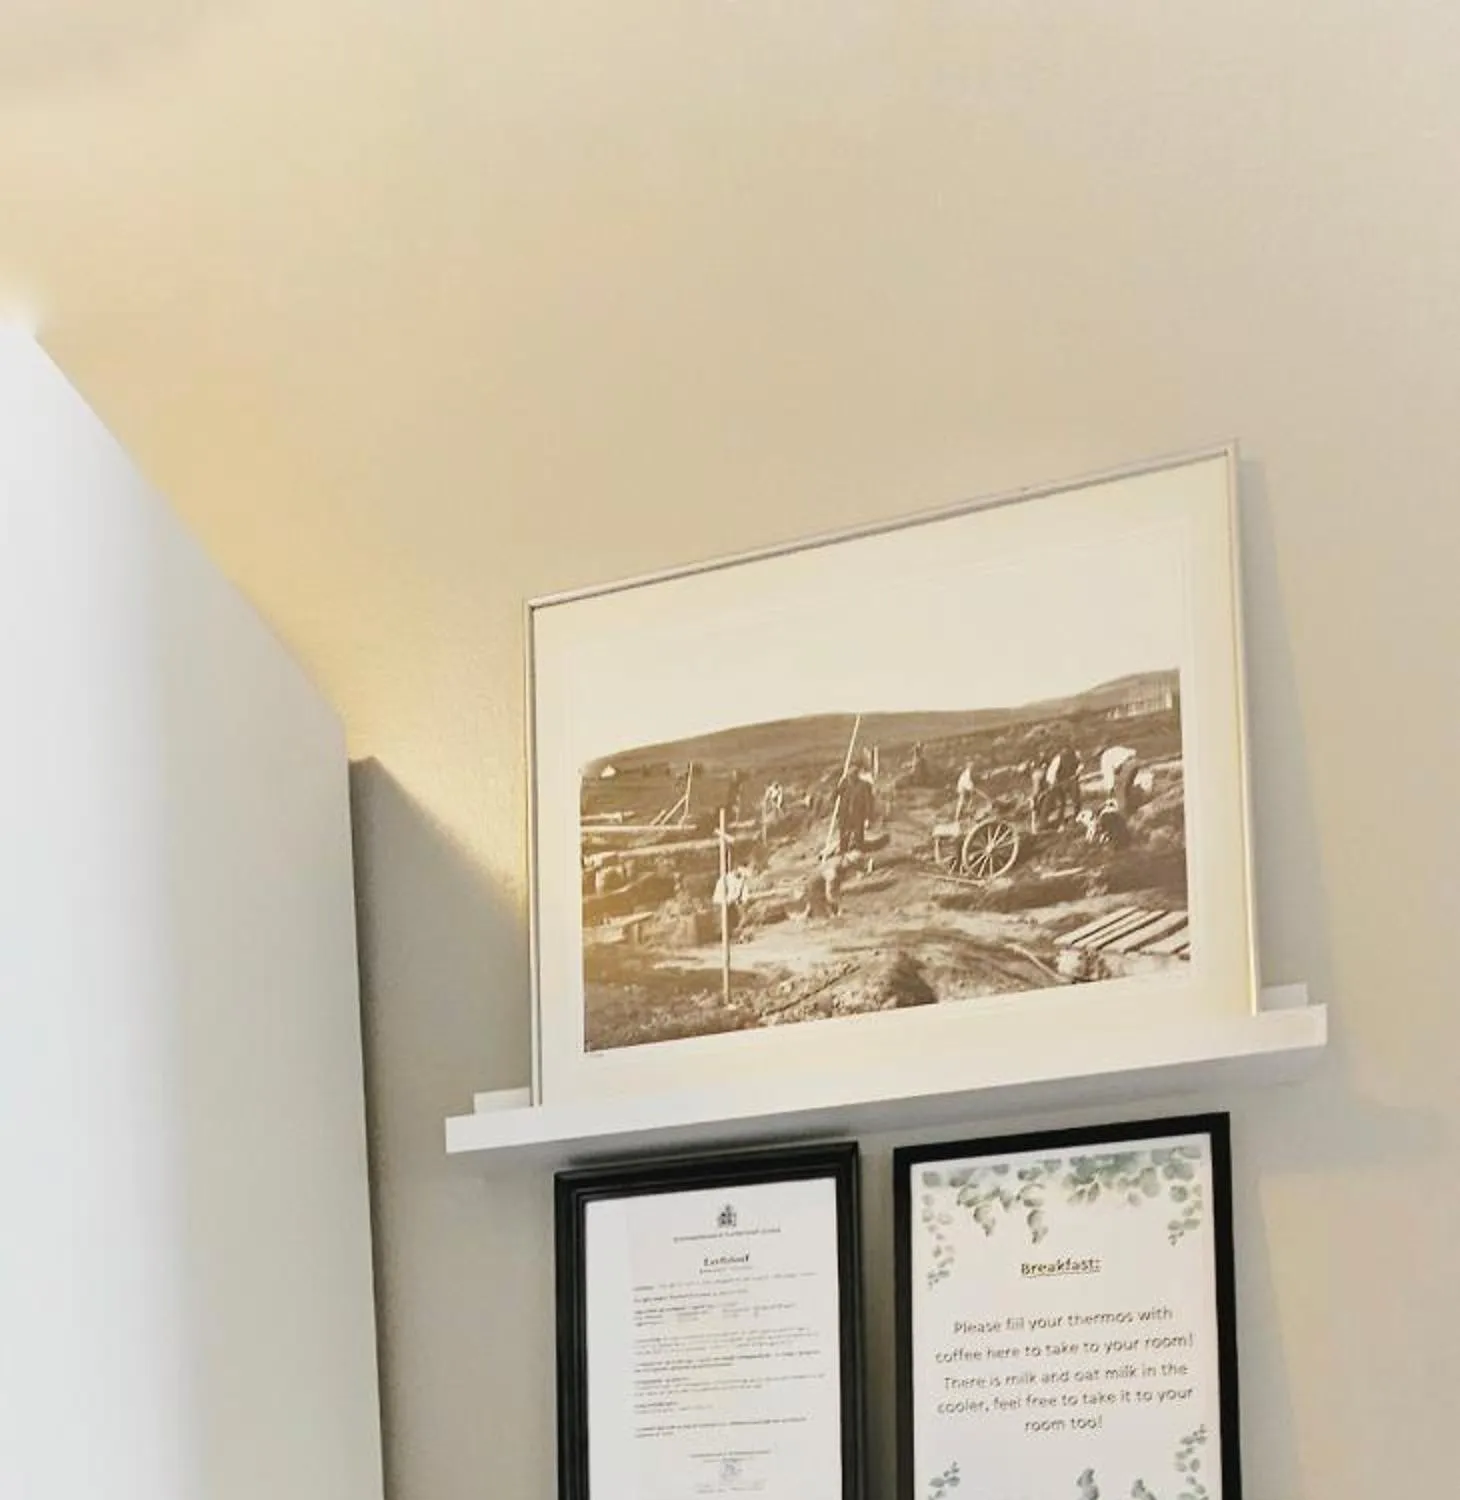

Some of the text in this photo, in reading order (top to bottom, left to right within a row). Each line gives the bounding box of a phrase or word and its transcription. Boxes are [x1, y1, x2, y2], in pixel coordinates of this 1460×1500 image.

[1021, 1257, 1102, 1276] Breakfast:
[953, 1319, 1001, 1334] Please
[1028, 1316, 1064, 1332] your
[1067, 1311, 1133, 1326] thermos
[1138, 1306, 1173, 1321] with
[935, 1331, 1193, 1363] coffee here to take to your room!
[943, 1362, 1189, 1390] There is milk and oat milk in the
[937, 1387, 1193, 1414] cooler, feel free to take it to your
[1024, 1413, 1103, 1433] room too!
